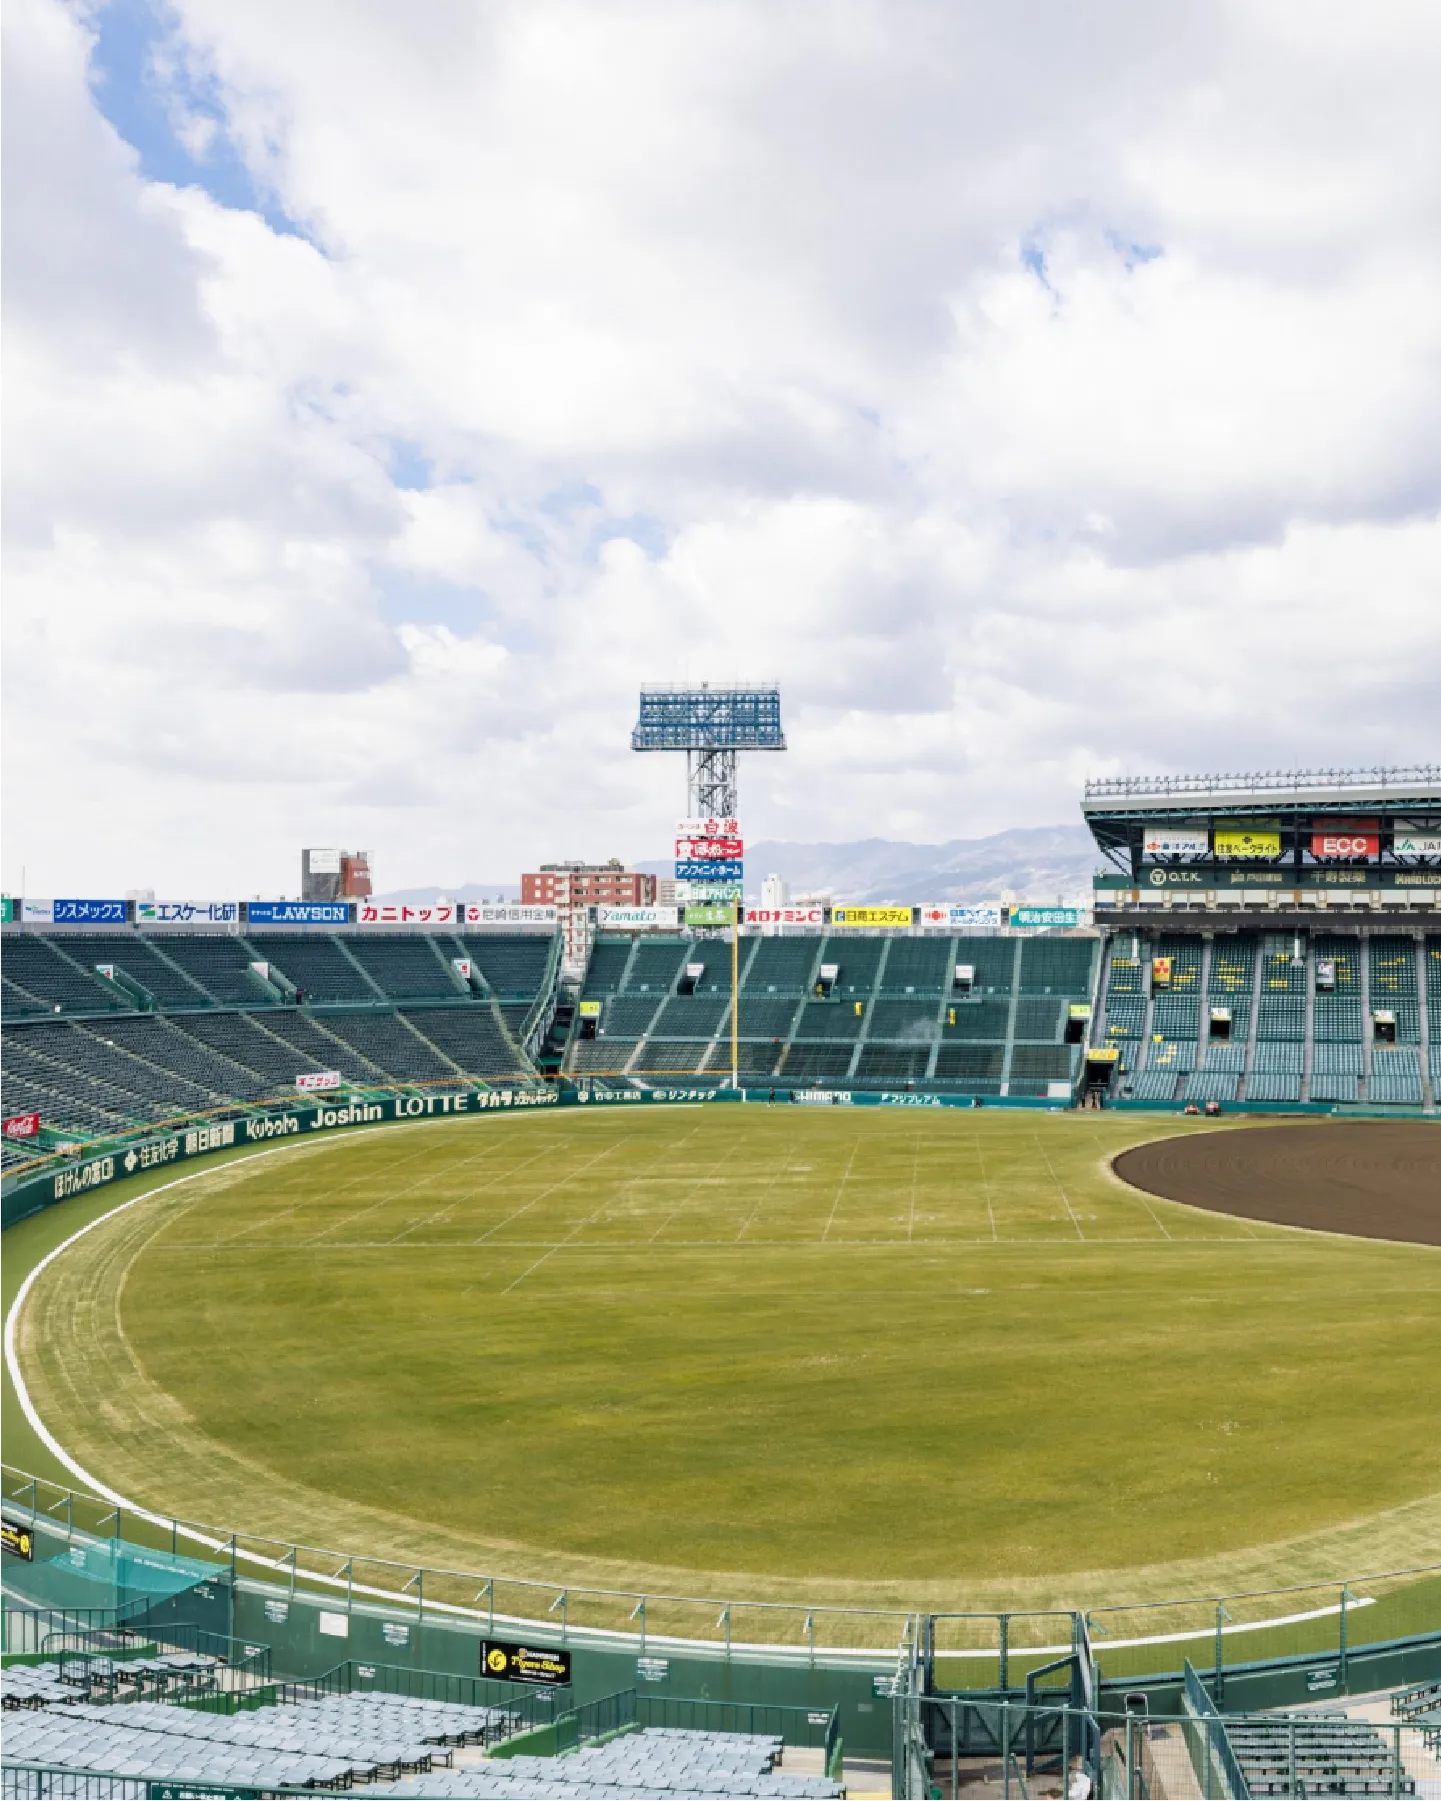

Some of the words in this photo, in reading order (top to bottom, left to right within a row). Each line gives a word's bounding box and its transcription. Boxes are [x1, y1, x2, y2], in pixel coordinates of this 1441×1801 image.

[1323, 838, 1367, 853] ECC
[55, 903, 124, 920] シスメックス
[156, 904, 238, 922] エスケー化研
[272, 906, 346, 921] LAWSON
[361, 906, 453, 922] カニトップ
[482, 908, 556, 921] 尼崎信用金庫
[600, 910, 657, 921] Yamato
[746, 911, 822, 922] オロナミンC
[476, 1092, 513, 1108] タカラ
[793, 1091, 851, 1101] SHIMANO
[394, 1095, 467, 1117] LOTTE
[310, 1103, 382, 1128] Joshin
[247, 1113, 298, 1139] Kubota
[55, 1157, 114, 1199] ほけんの窓口
